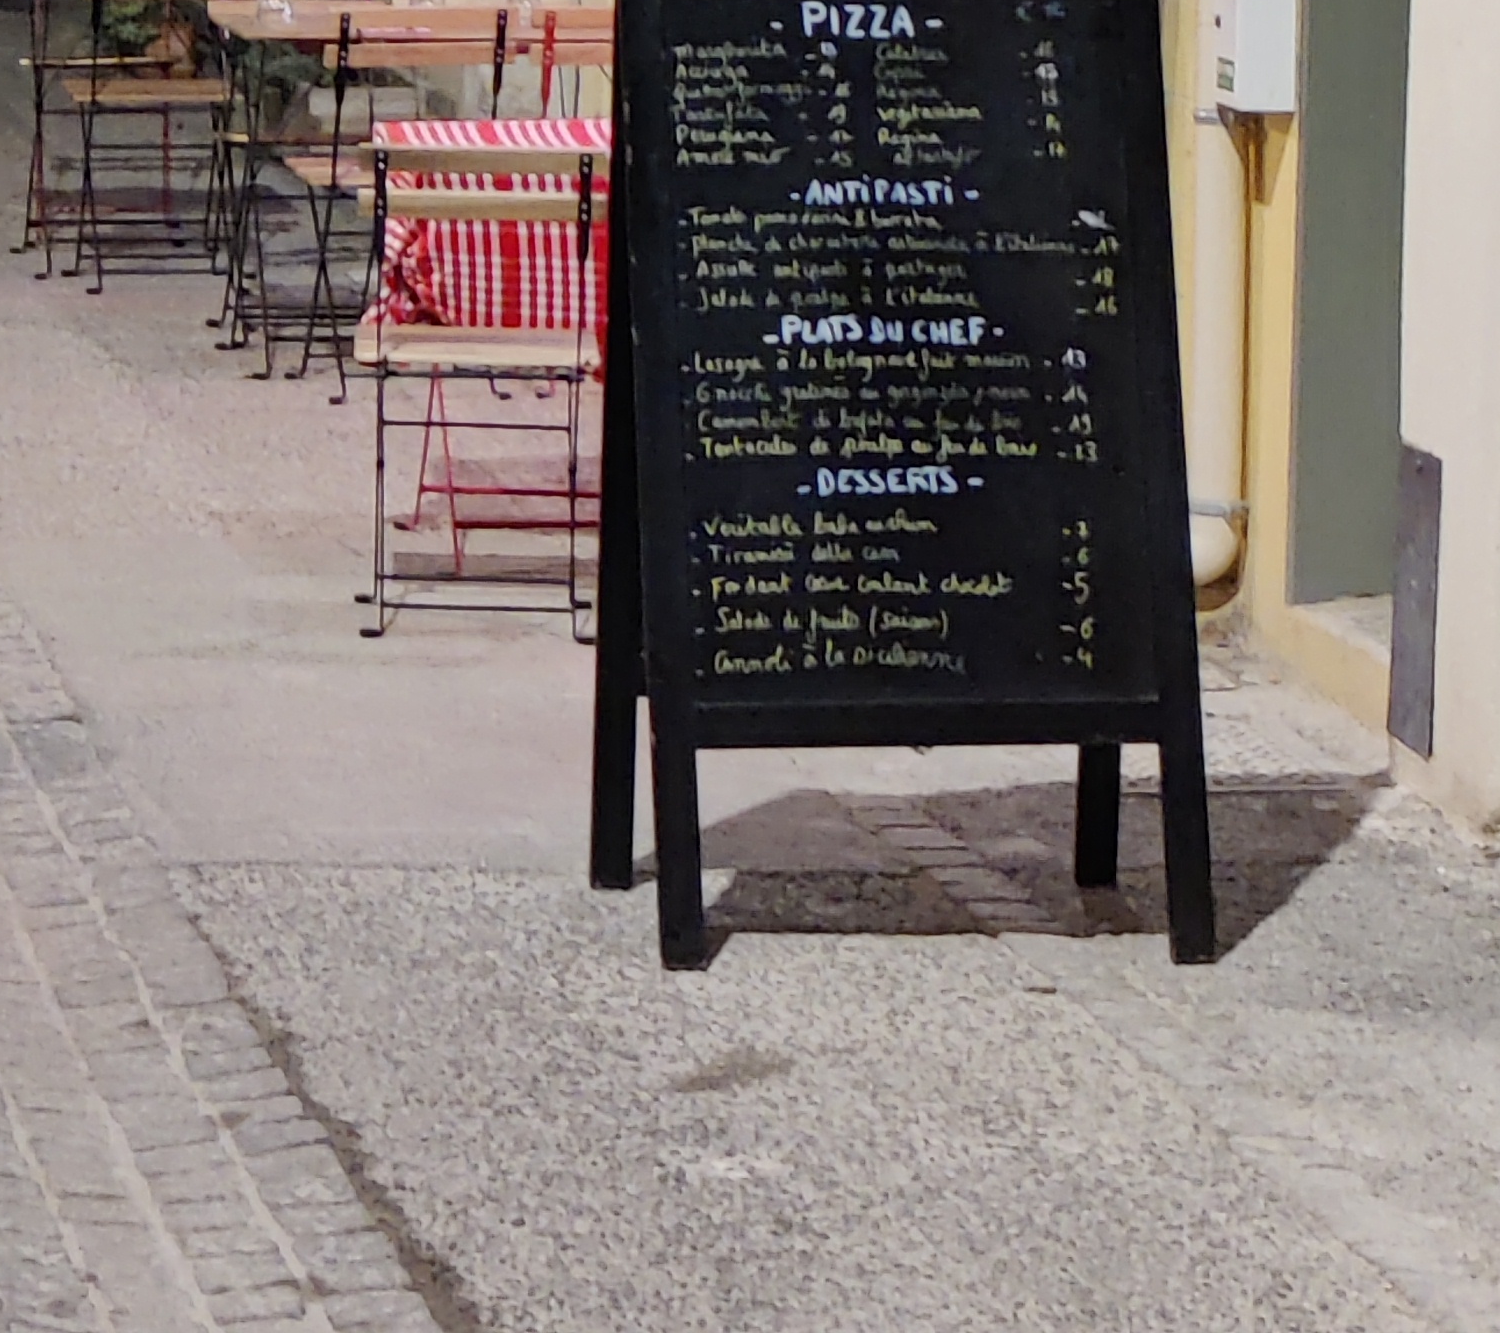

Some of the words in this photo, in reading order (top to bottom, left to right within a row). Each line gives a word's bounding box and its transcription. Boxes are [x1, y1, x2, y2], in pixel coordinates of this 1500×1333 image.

[801, 0, 915, 39] PIZZA
[780, 311, 864, 346] PLATS
[869, 314, 904, 345] DU
[911, 315, 987, 347] CHEF
[816, 465, 960, 498] DESSERTS
[1073, 570, 1091, 606] 5
[1079, 615, 1096, 640] 6
